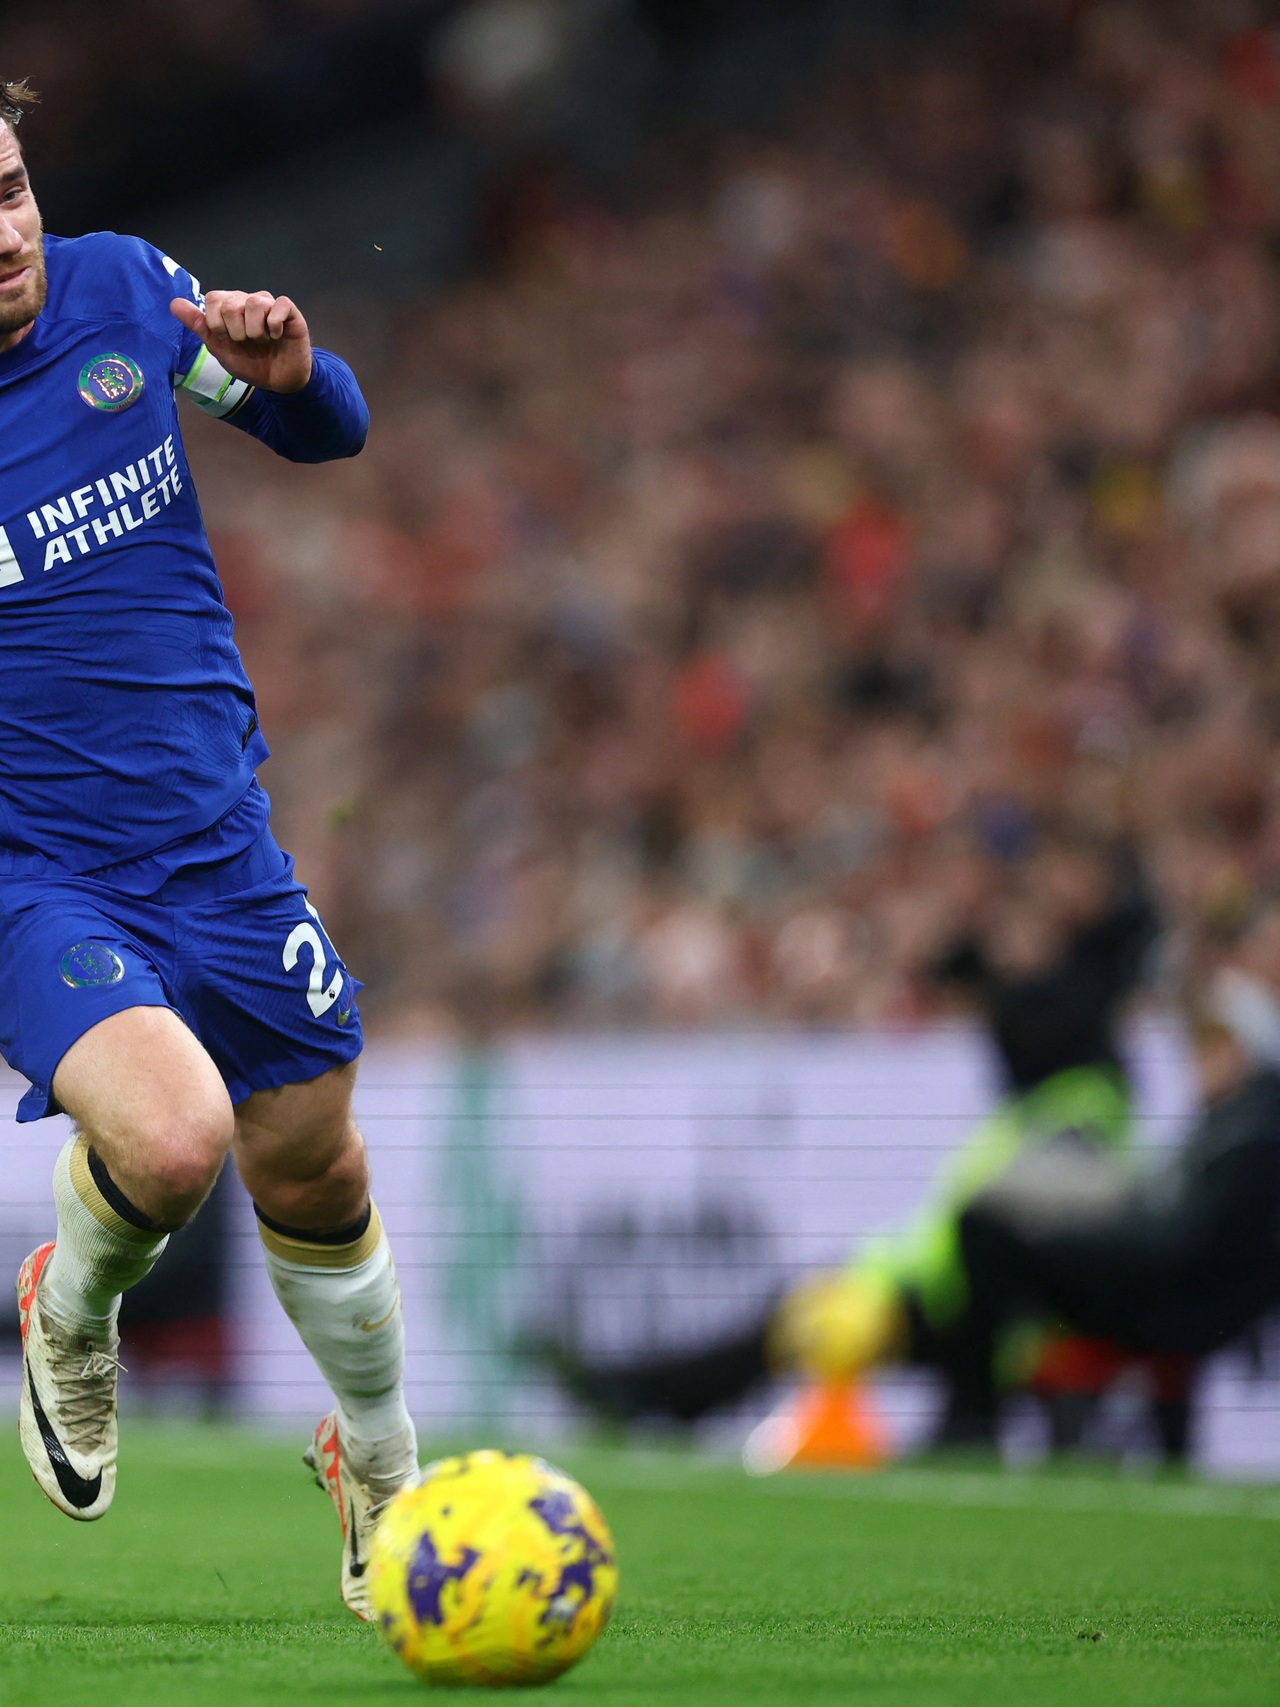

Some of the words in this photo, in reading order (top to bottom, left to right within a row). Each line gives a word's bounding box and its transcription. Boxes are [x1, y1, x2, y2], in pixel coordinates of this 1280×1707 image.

[27, 434, 175, 539] INFINITE
[43, 464, 183, 571] ATHLETE
[282, 893, 346, 1018] 2
